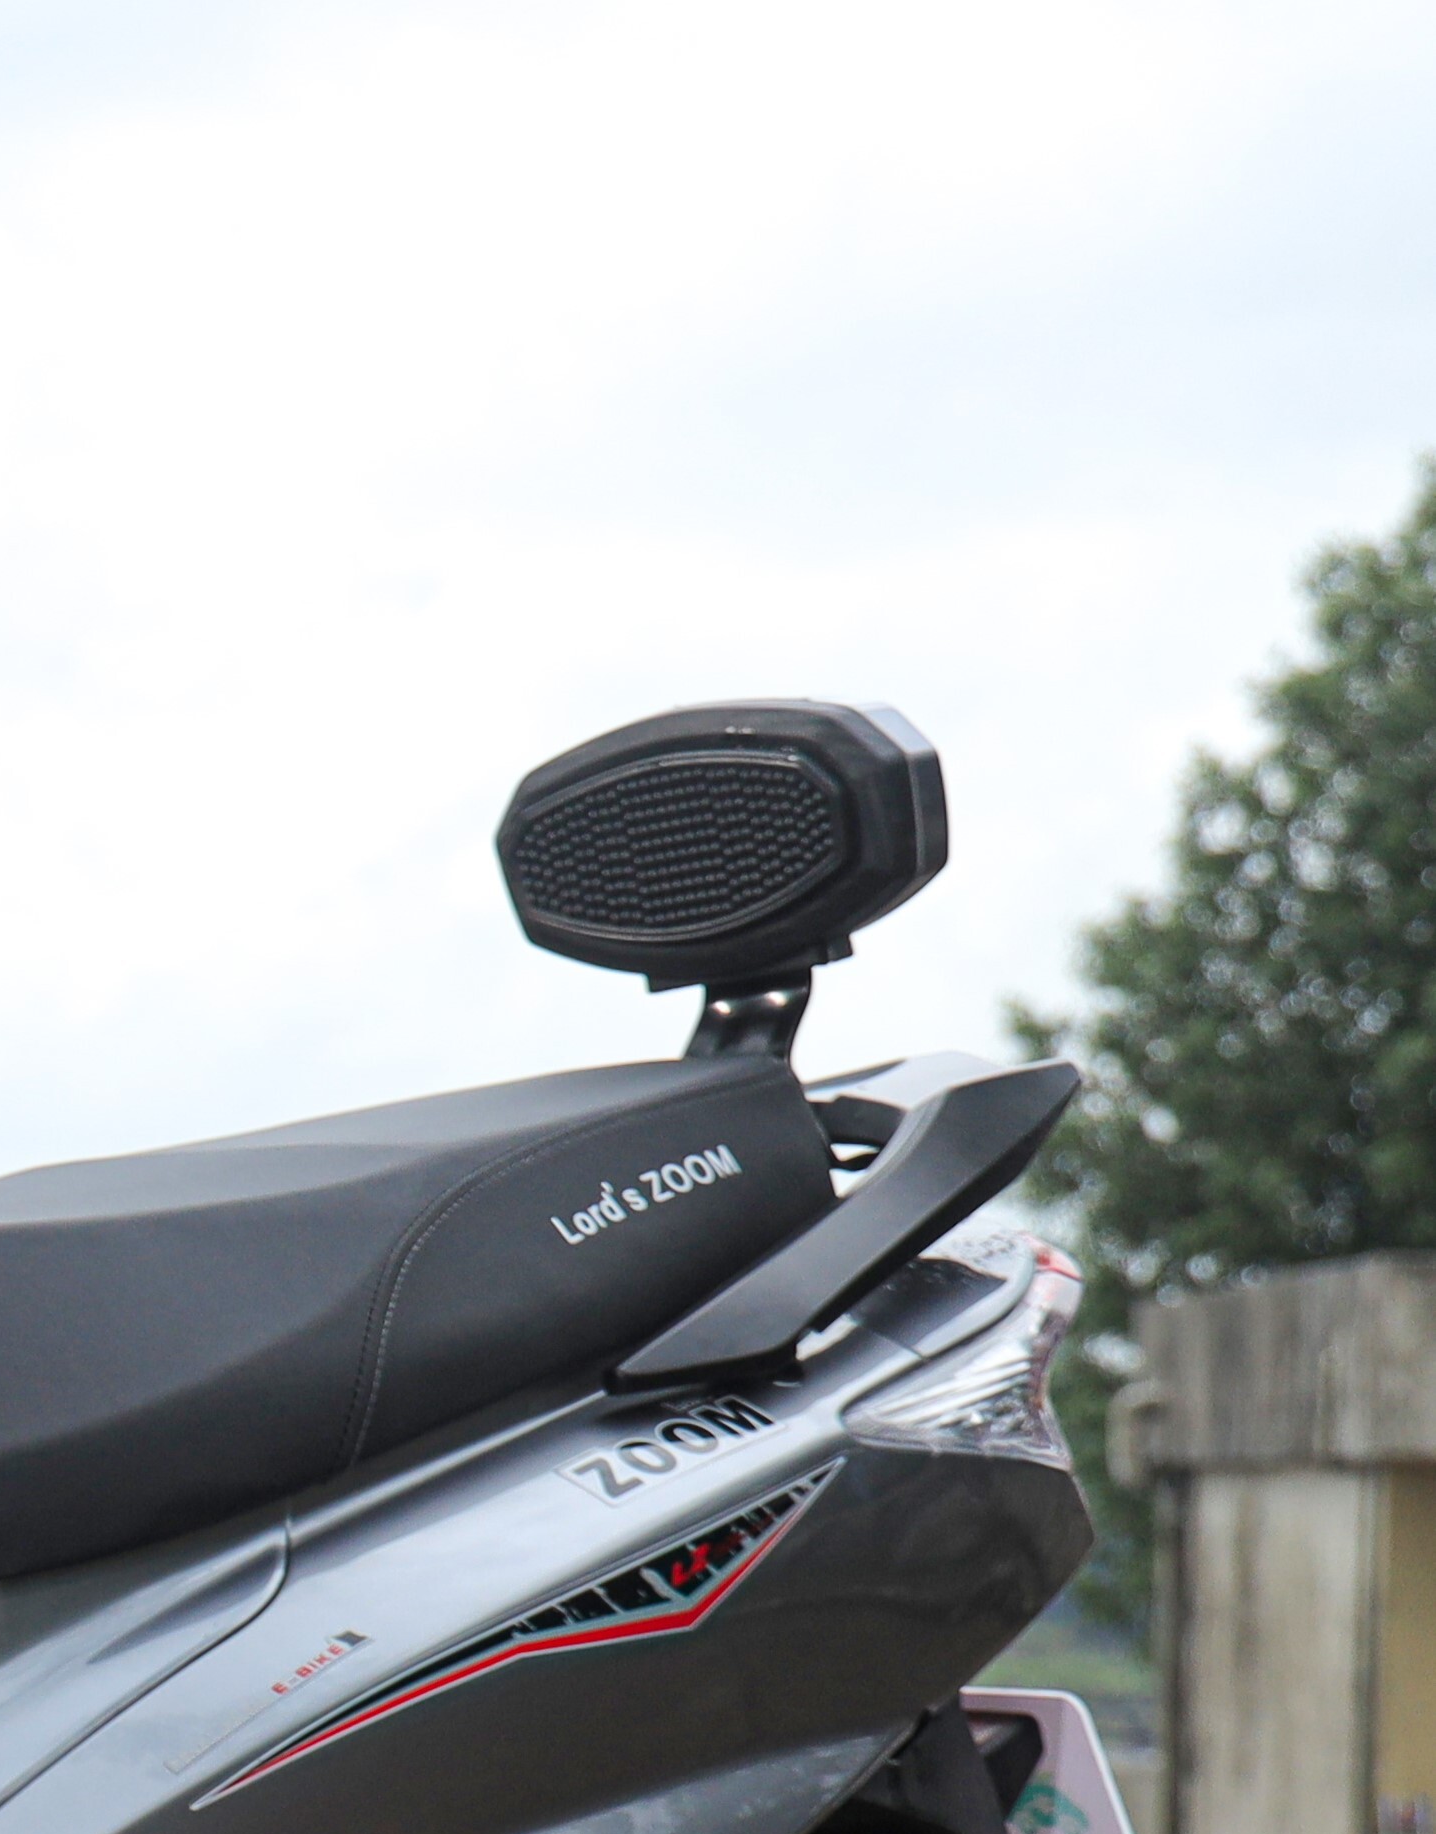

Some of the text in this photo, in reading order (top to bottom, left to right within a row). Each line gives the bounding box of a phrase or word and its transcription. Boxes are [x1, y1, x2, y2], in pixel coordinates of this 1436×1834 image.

[550, 1144, 742, 1245] Lord's ZOOM
[571, 1397, 776, 1499] ZOOM
